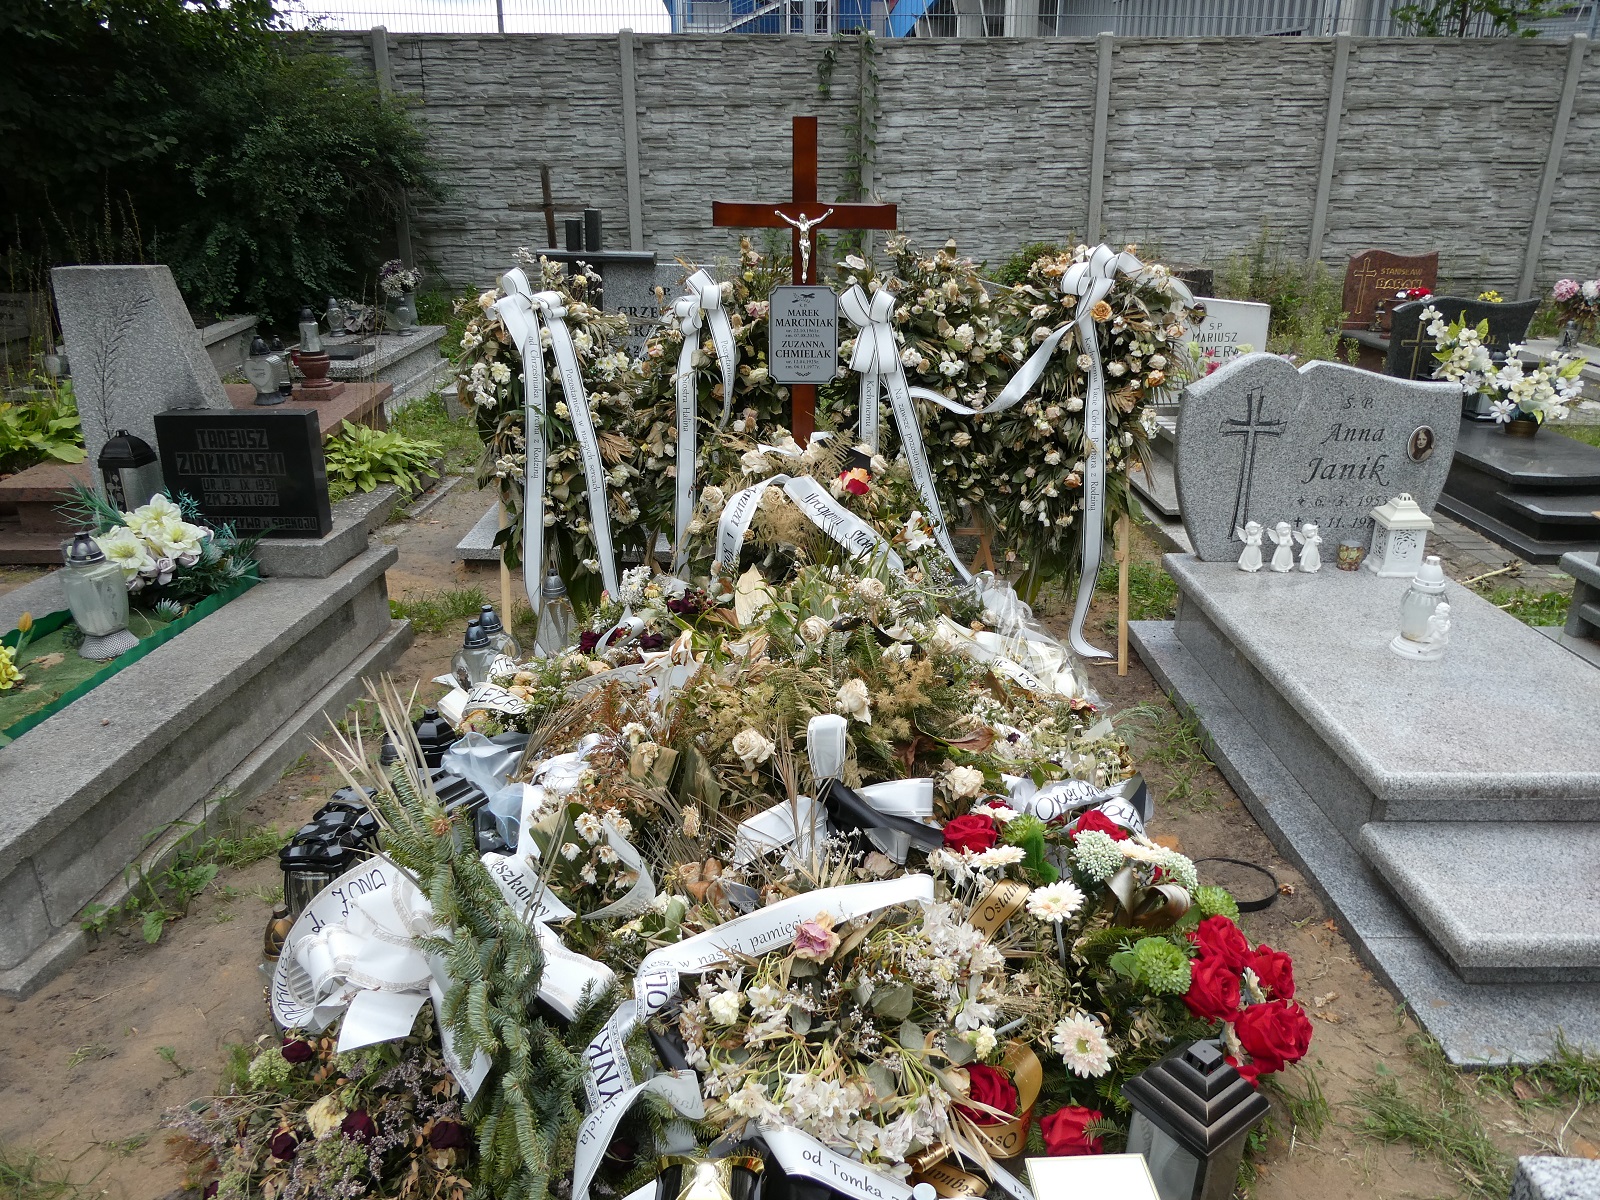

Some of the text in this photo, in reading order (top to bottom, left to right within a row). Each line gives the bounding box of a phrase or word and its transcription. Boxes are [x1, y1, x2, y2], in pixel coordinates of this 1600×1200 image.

[618, 306, 661, 318] GRZE
[775, 318, 834, 327] MARCINIAK
[787, 309, 819, 317] MAREK
[528, 336, 537, 346] od
[781, 340, 825, 348] ZUZANNA
[1192, 332, 1238, 343] MARIUSZ
[775, 349, 831, 358] CHMIELAK
[865, 380, 875, 427] Kochanemu
[1091, 385, 1100, 406] Tacie
[894, 387, 902, 400] Na
[898, 403, 910, 429] zawsze
[682, 407, 691, 432] Halina
[1091, 409, 1101, 433] Córka
[196, 429, 268, 449] TADEUSZ
[1320, 422, 1385, 445] Anna
[531, 447, 541, 479] Rodziną
[1301, 454, 1390, 487] Janik
[1088, 481, 1099, 511] Rodziną
[678, 960, 690, 969] w
[802, 1149, 884, 1199] od Tomka
